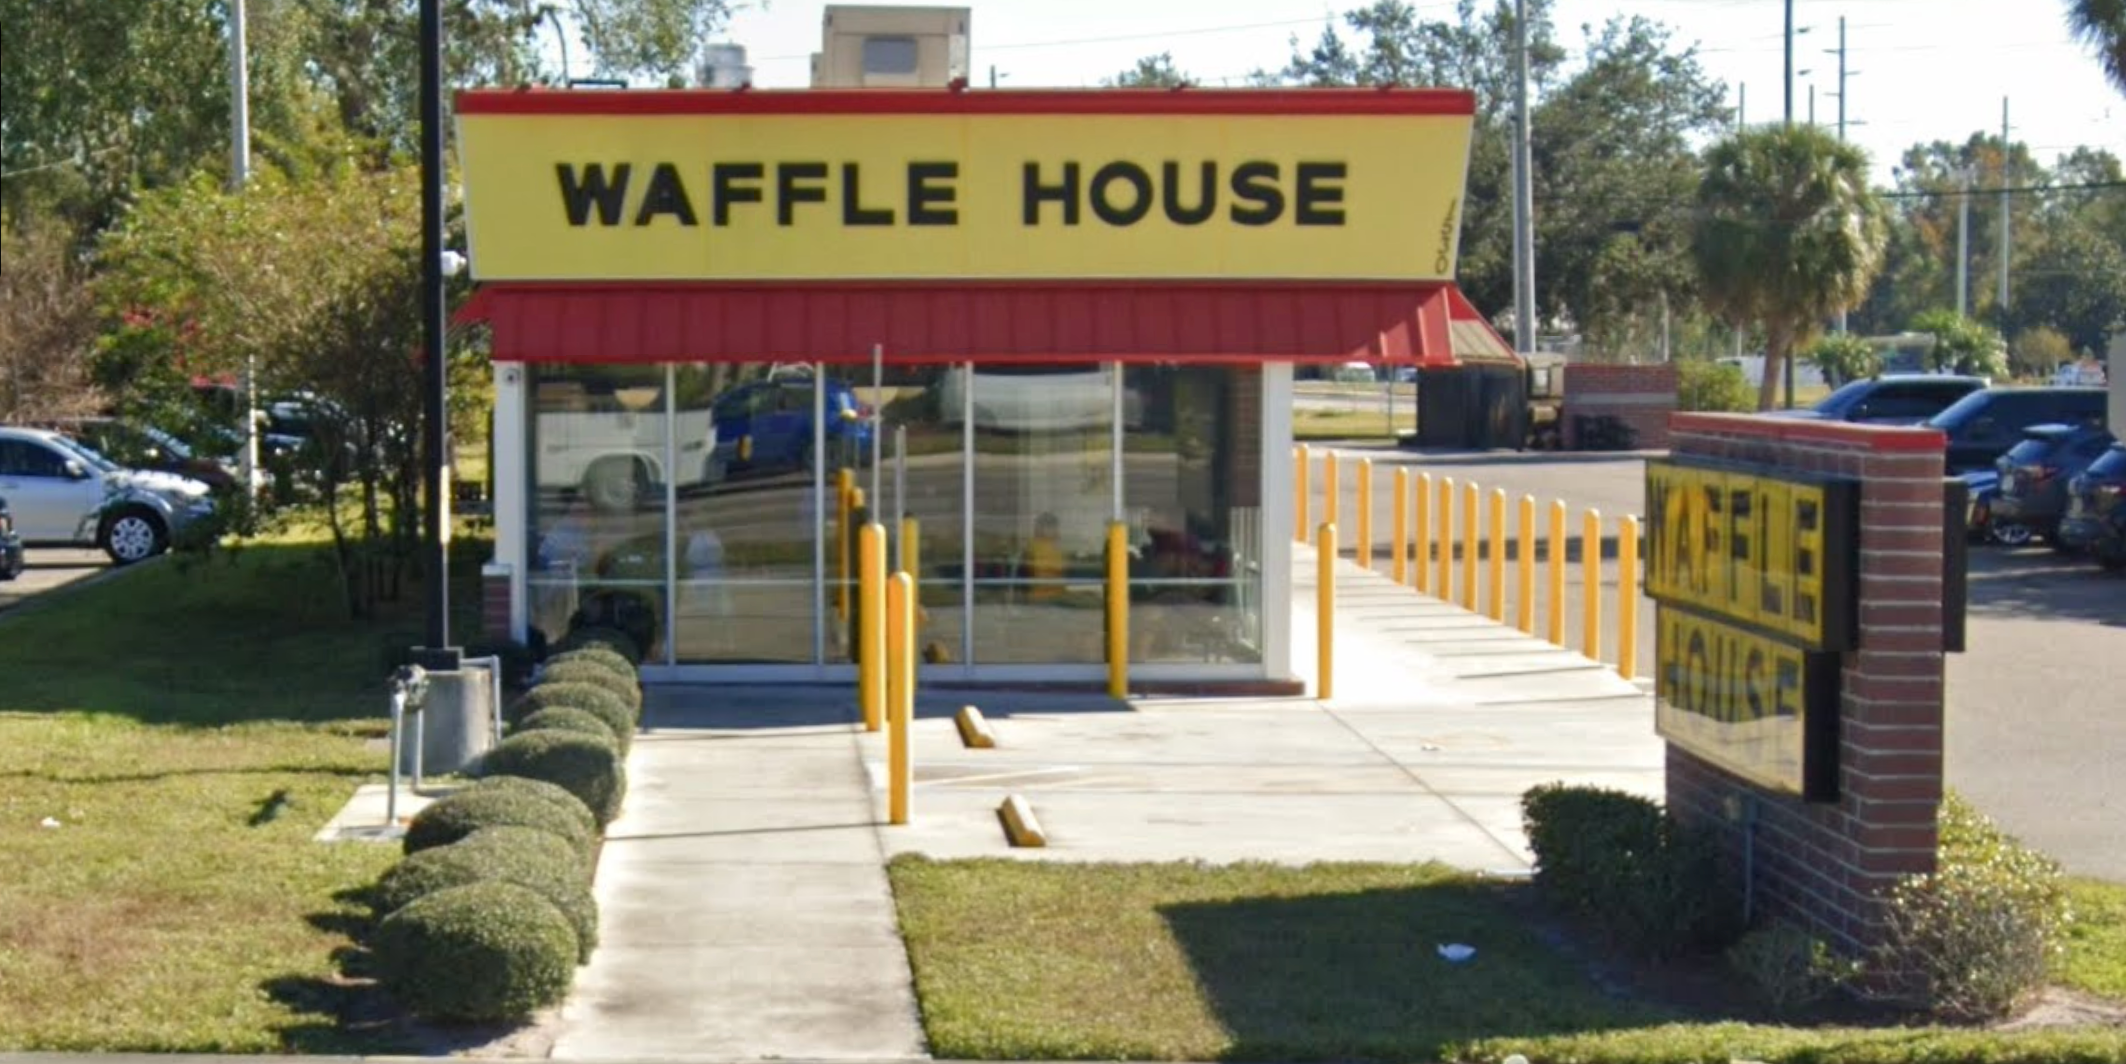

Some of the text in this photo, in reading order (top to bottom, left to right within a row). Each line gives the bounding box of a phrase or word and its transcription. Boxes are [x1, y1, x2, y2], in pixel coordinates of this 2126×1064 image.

[555, 160, 1348, 227] WAFFLE HOUSE
[1647, 475, 1818, 625] WAFFLE
[1661, 620, 1800, 768] HOUSE
